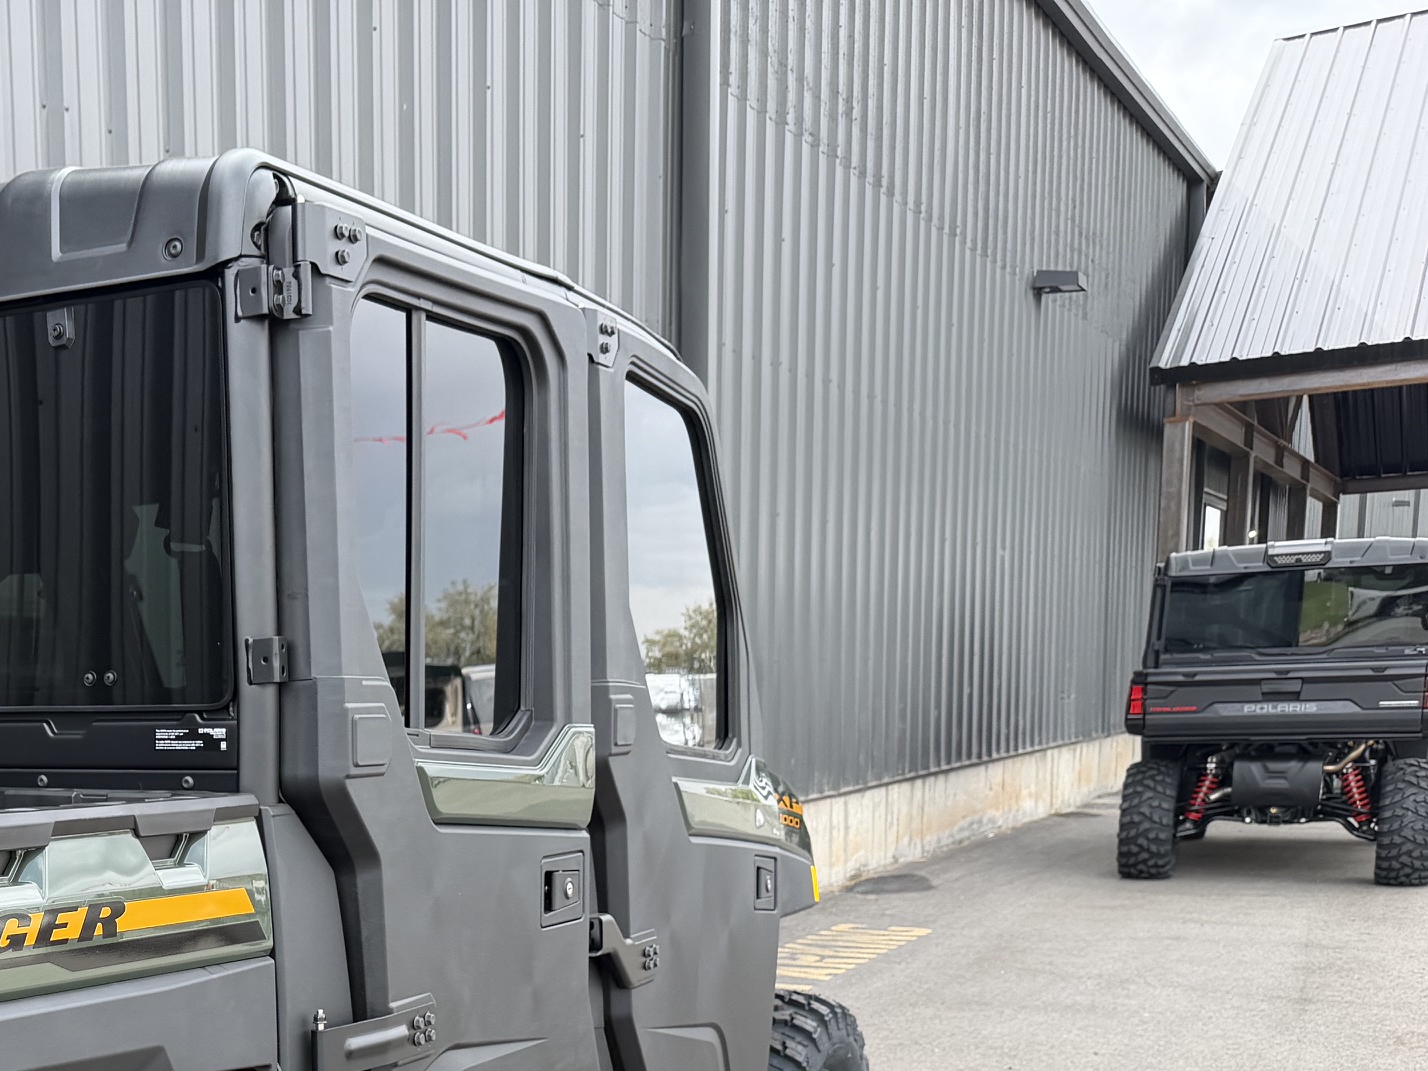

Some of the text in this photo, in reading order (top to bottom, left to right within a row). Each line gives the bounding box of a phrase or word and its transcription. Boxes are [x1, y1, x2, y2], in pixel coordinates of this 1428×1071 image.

[1243, 702, 1318, 714] POLARIS
[779, 813, 801, 829] 1000
[775, 922, 933, 991] ARKING
